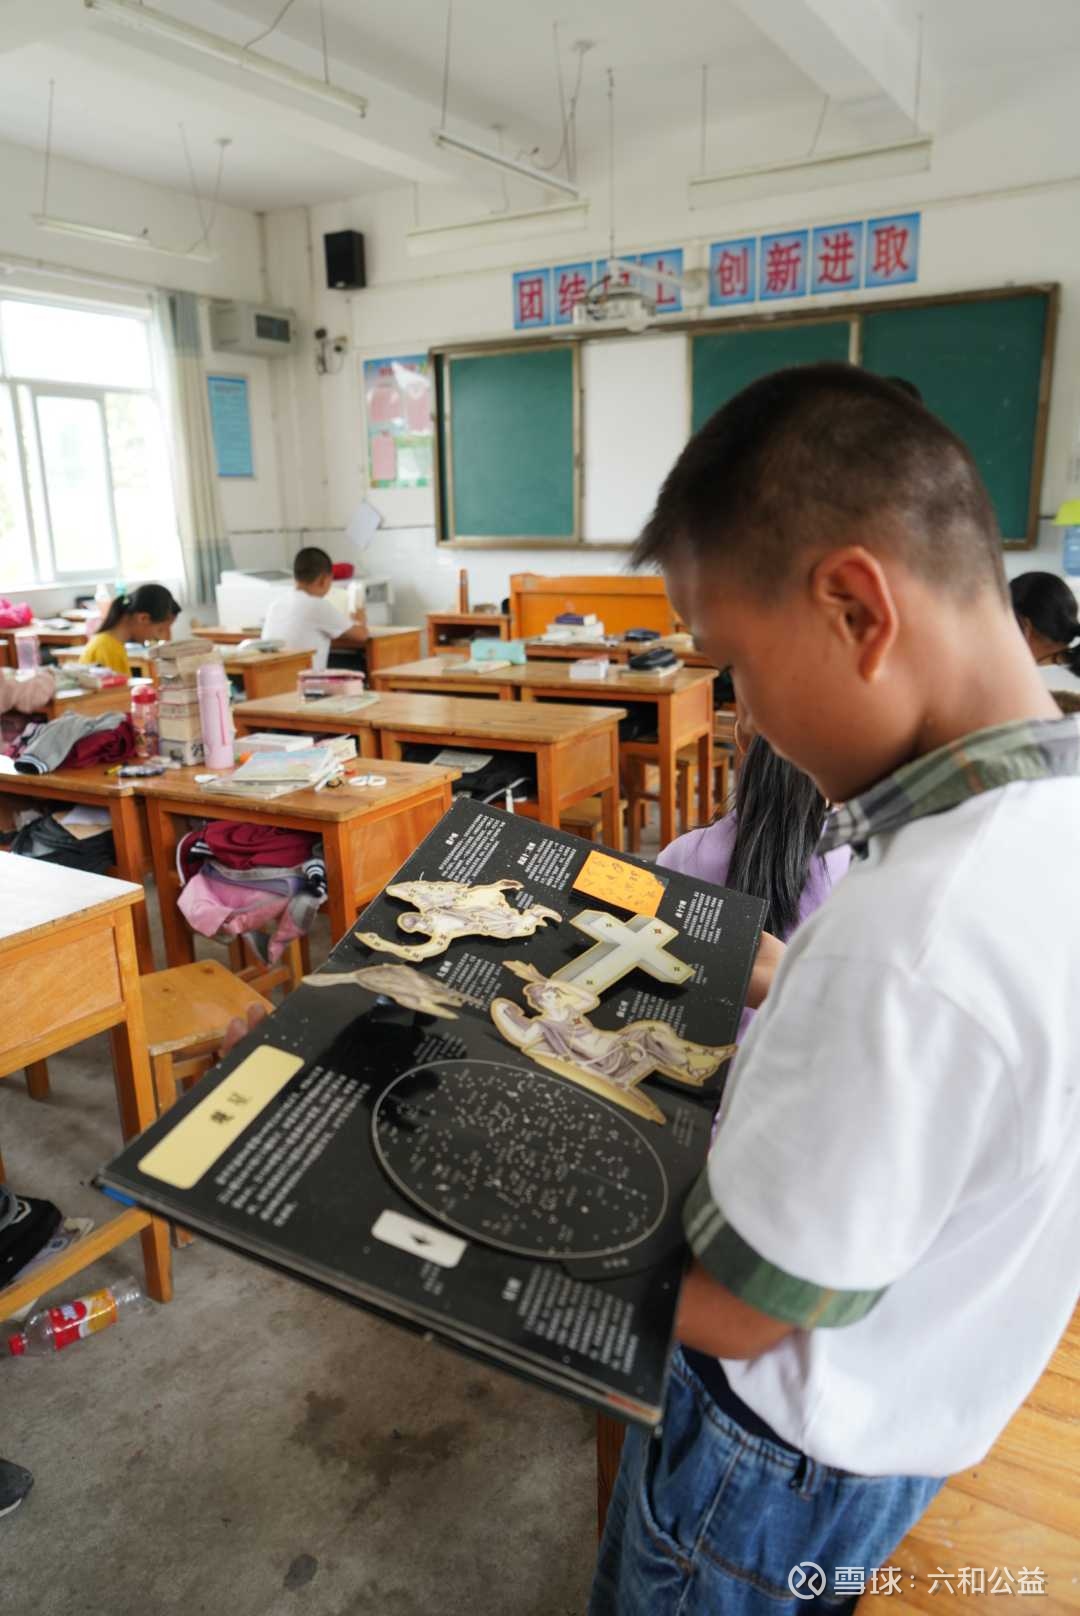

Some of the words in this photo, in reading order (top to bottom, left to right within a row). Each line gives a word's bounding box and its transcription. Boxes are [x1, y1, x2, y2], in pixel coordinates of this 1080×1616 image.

[518, 258, 676, 323] 团结上
[715, 224, 910, 297] 创新进取
